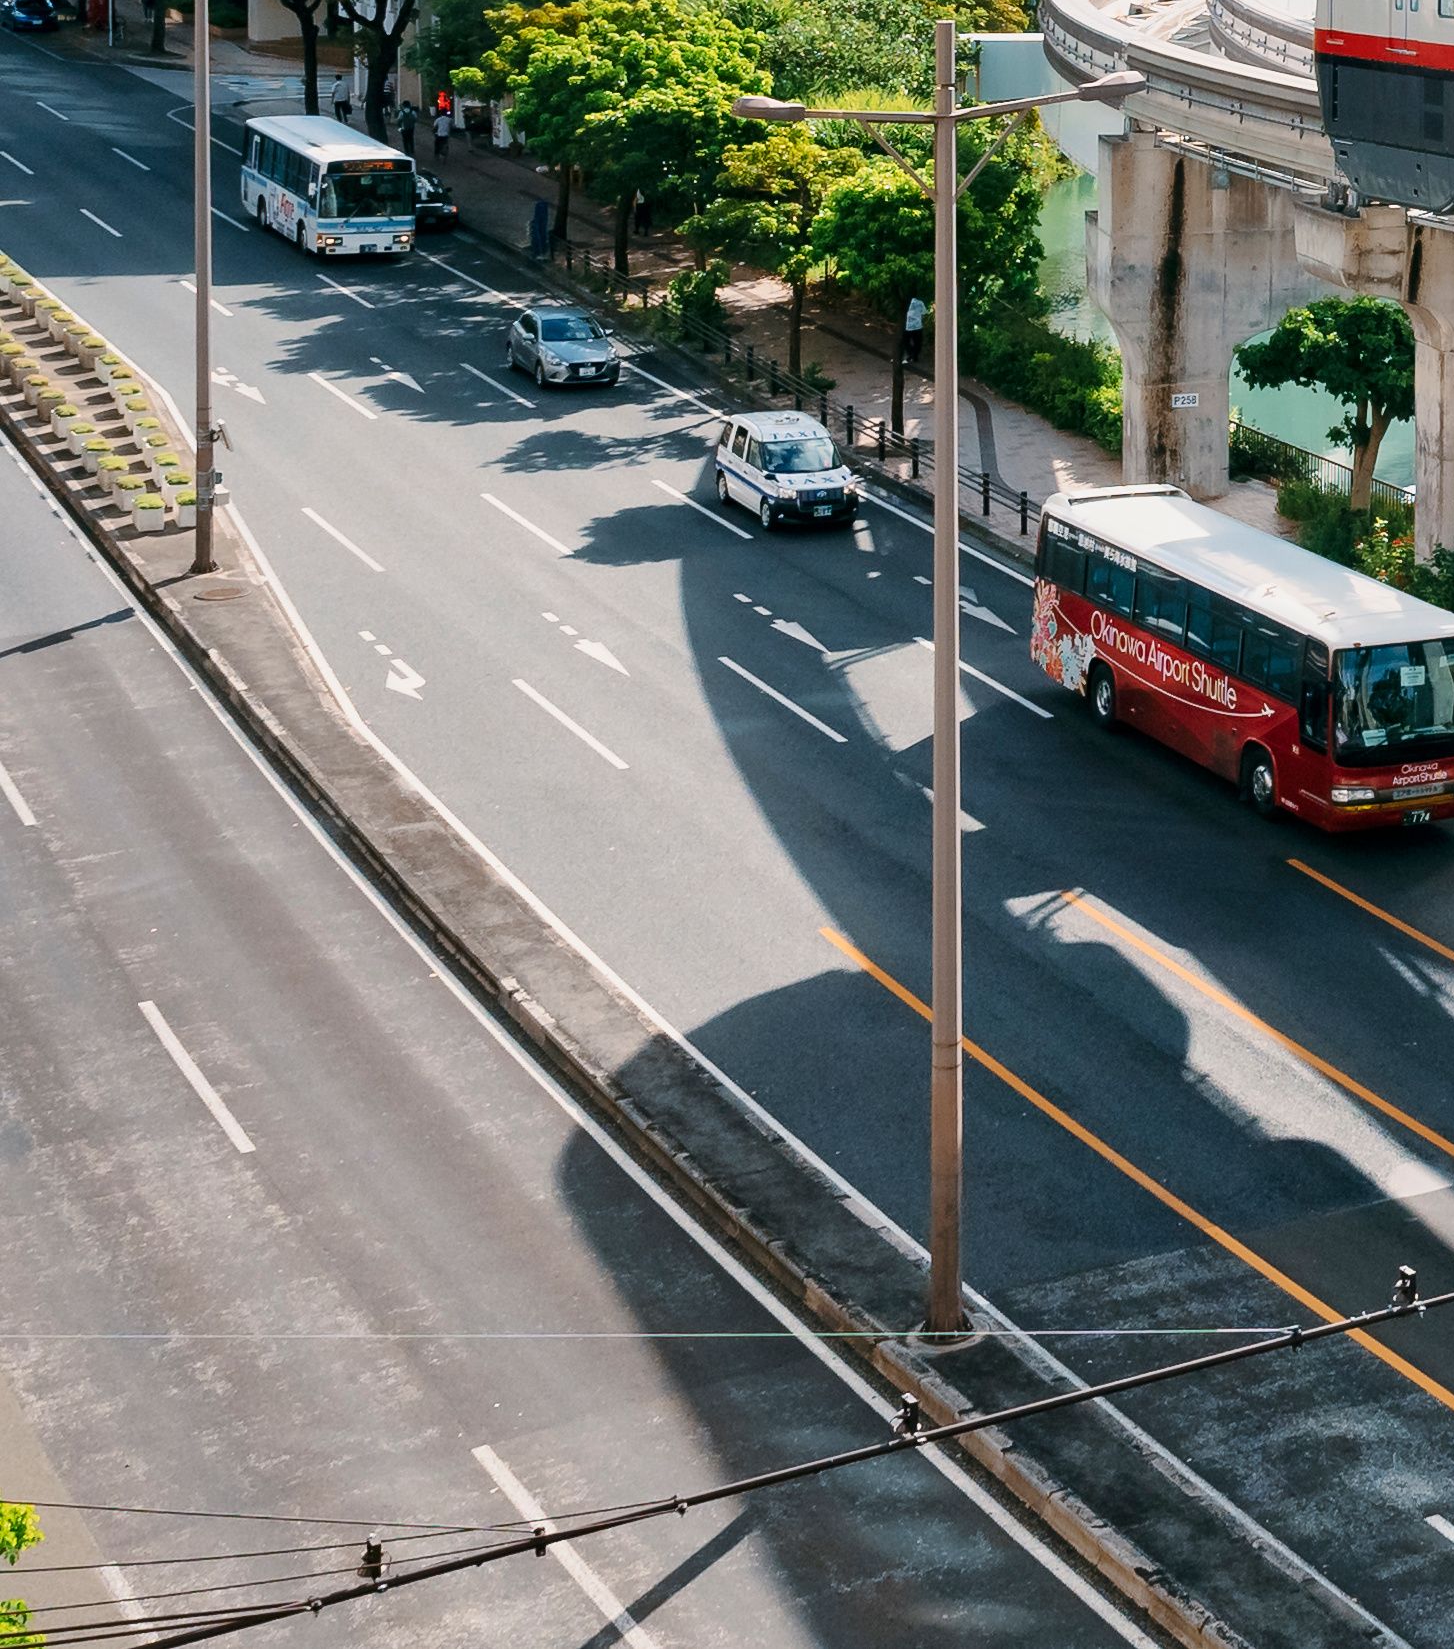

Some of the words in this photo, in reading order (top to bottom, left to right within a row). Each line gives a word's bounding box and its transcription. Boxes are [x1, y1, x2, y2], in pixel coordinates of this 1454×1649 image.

[1173, 395, 1197, 406] P258
[769, 430, 818, 440] TAXI
[785, 474, 848, 486] TAXI
[1090, 610, 1147, 665] Okinawa
[1146, 640, 1190, 686] Airport
[1191, 661, 1238, 710] Shuttle
